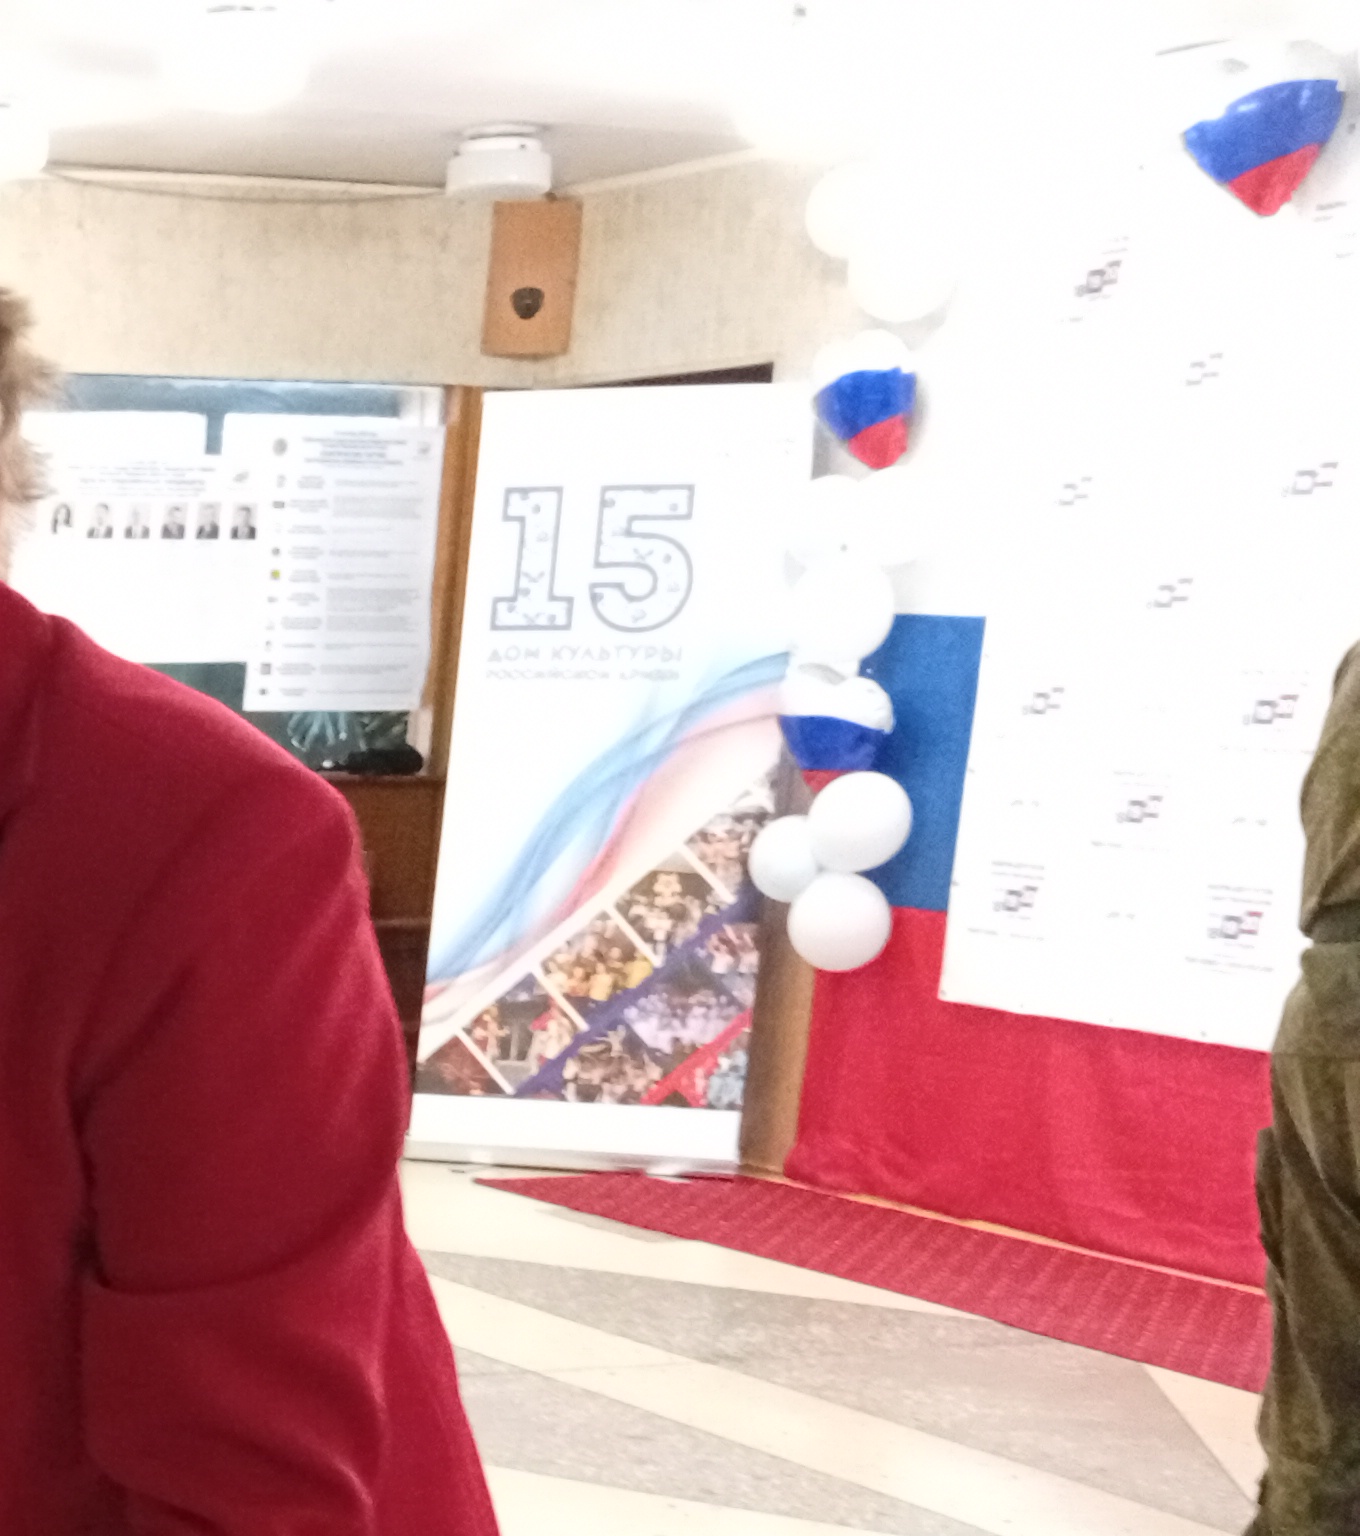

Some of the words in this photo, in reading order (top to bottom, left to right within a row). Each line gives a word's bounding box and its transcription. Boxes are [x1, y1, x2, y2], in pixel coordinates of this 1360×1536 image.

[489, 484, 696, 634] 15
[486, 645, 540, 663] ДОМ
[551, 645, 682, 663] КУЛЬТУРЫ
